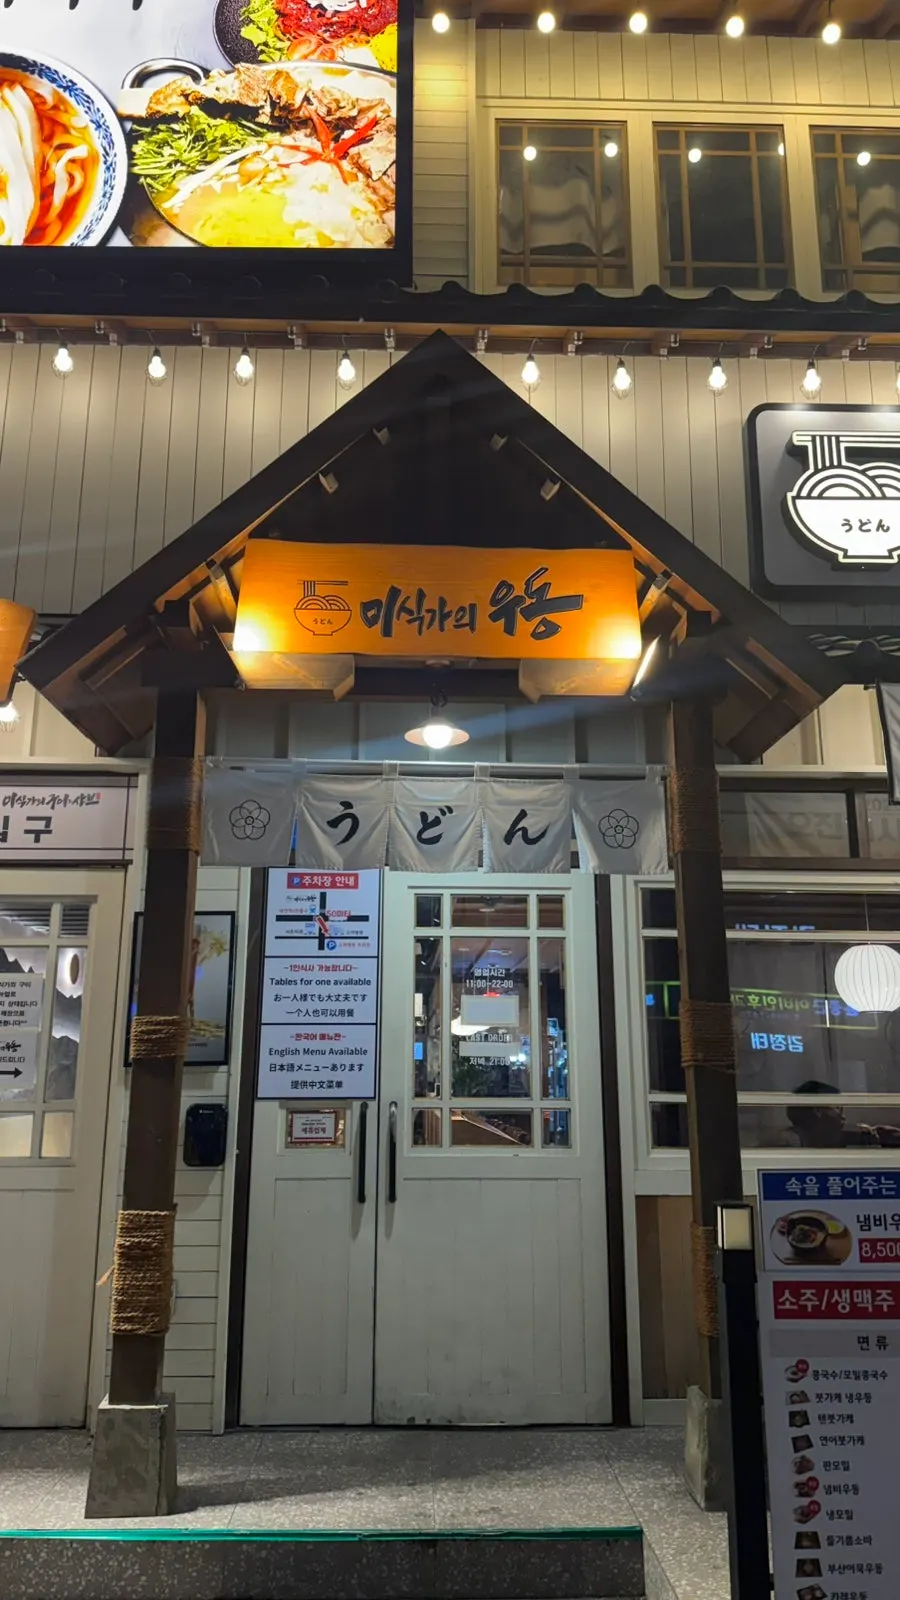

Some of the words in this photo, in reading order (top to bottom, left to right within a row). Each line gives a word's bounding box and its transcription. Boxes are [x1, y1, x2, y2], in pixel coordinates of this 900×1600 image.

[841, 518, 890, 533] うどん
[360, 584, 477, 638] 미식가의
[488, 566, 584, 640] 우동
[326, 800, 551, 847] うどん
[302, 875, 332, 887] 주차장
[335, 875, 355, 887] 안내
[269, 977, 298, 986] Tables
[300, 977, 312, 986] for
[333, 977, 371, 986] available
[274, 993, 367, 1002] お一人様でも大丈夫です
[286, 1008, 354, 1018] 一个人也可以用餐
[268, 1047, 300, 1058] English
[302, 1047, 327, 1056] Menu
[328, 1047, 368, 1056] Available
[269, 1063, 364, 1073] 日本語メニューあります
[291, 1080, 343, 1090] 提供中文菜单
[785, 1175, 820, 1196] 속을
[826, 1175, 897, 1196] 풀어주는
[777, 1288, 896, 1314] 소주/생맥주
